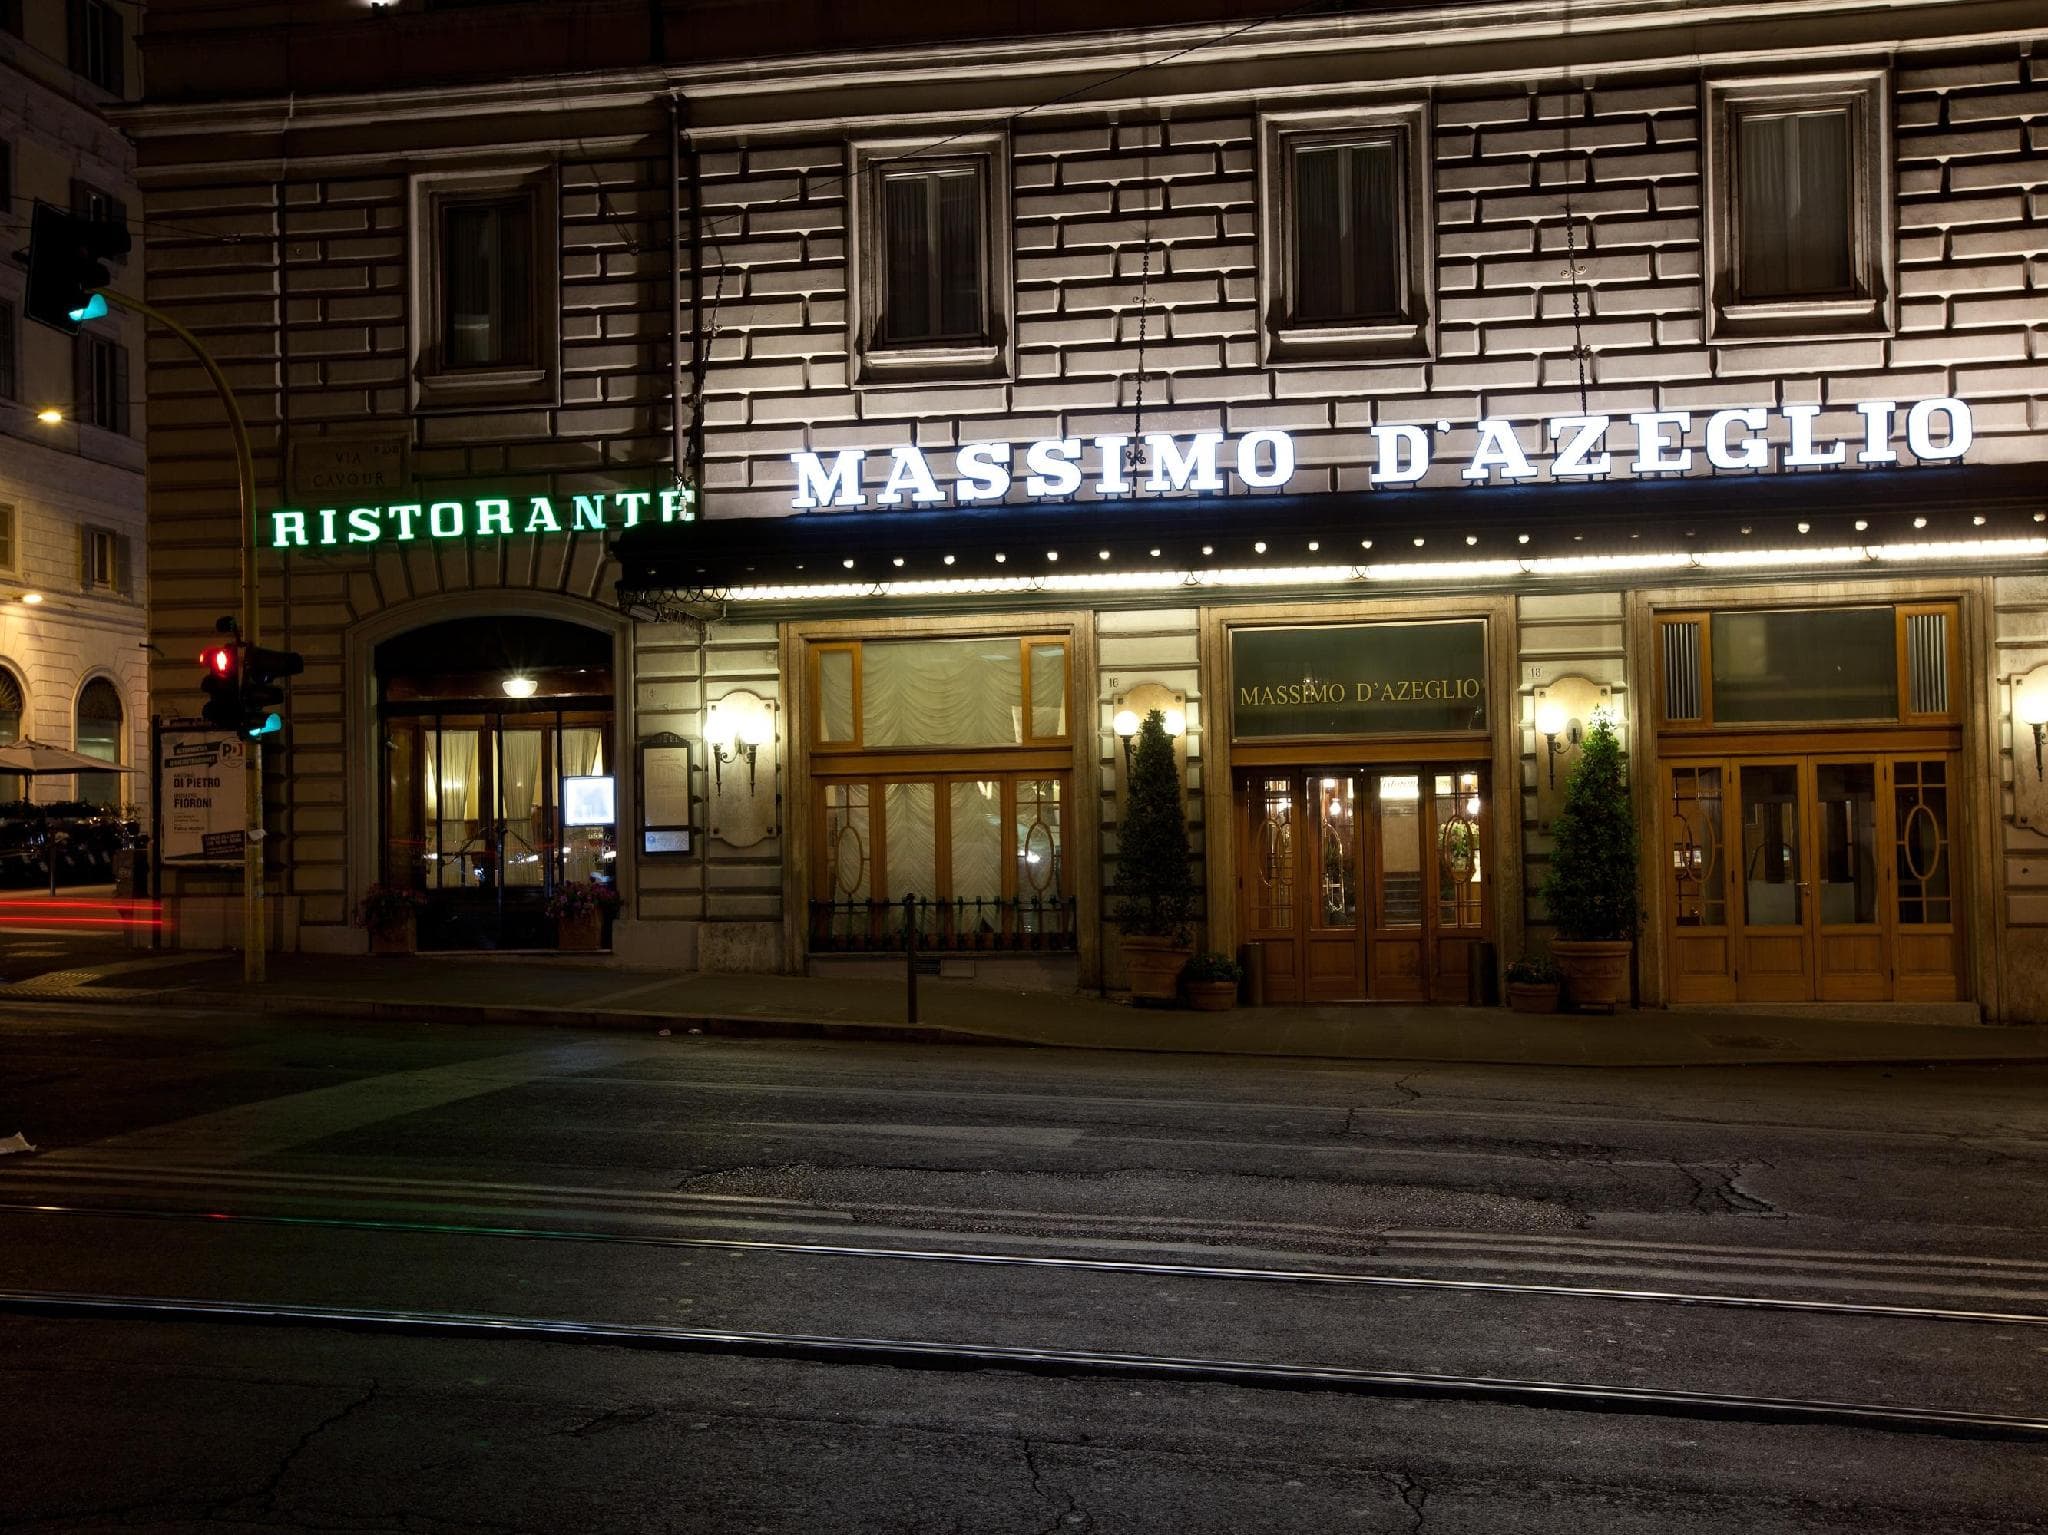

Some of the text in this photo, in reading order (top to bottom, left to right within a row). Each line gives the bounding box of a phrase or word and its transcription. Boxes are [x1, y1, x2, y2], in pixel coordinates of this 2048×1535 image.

[335, 450, 361, 464] VIA
[790, 397, 1974, 508] MASSIMO D'AZEGLIO
[312, 472, 385, 488] CAVOUR
[272, 490, 696, 547] RISTORANTE
[1240, 678, 1480, 706] MASSIMO D'AZEGLIO
[173, 777, 221, 788] DI PIETRO
[174, 797, 212, 808] FIORONI
